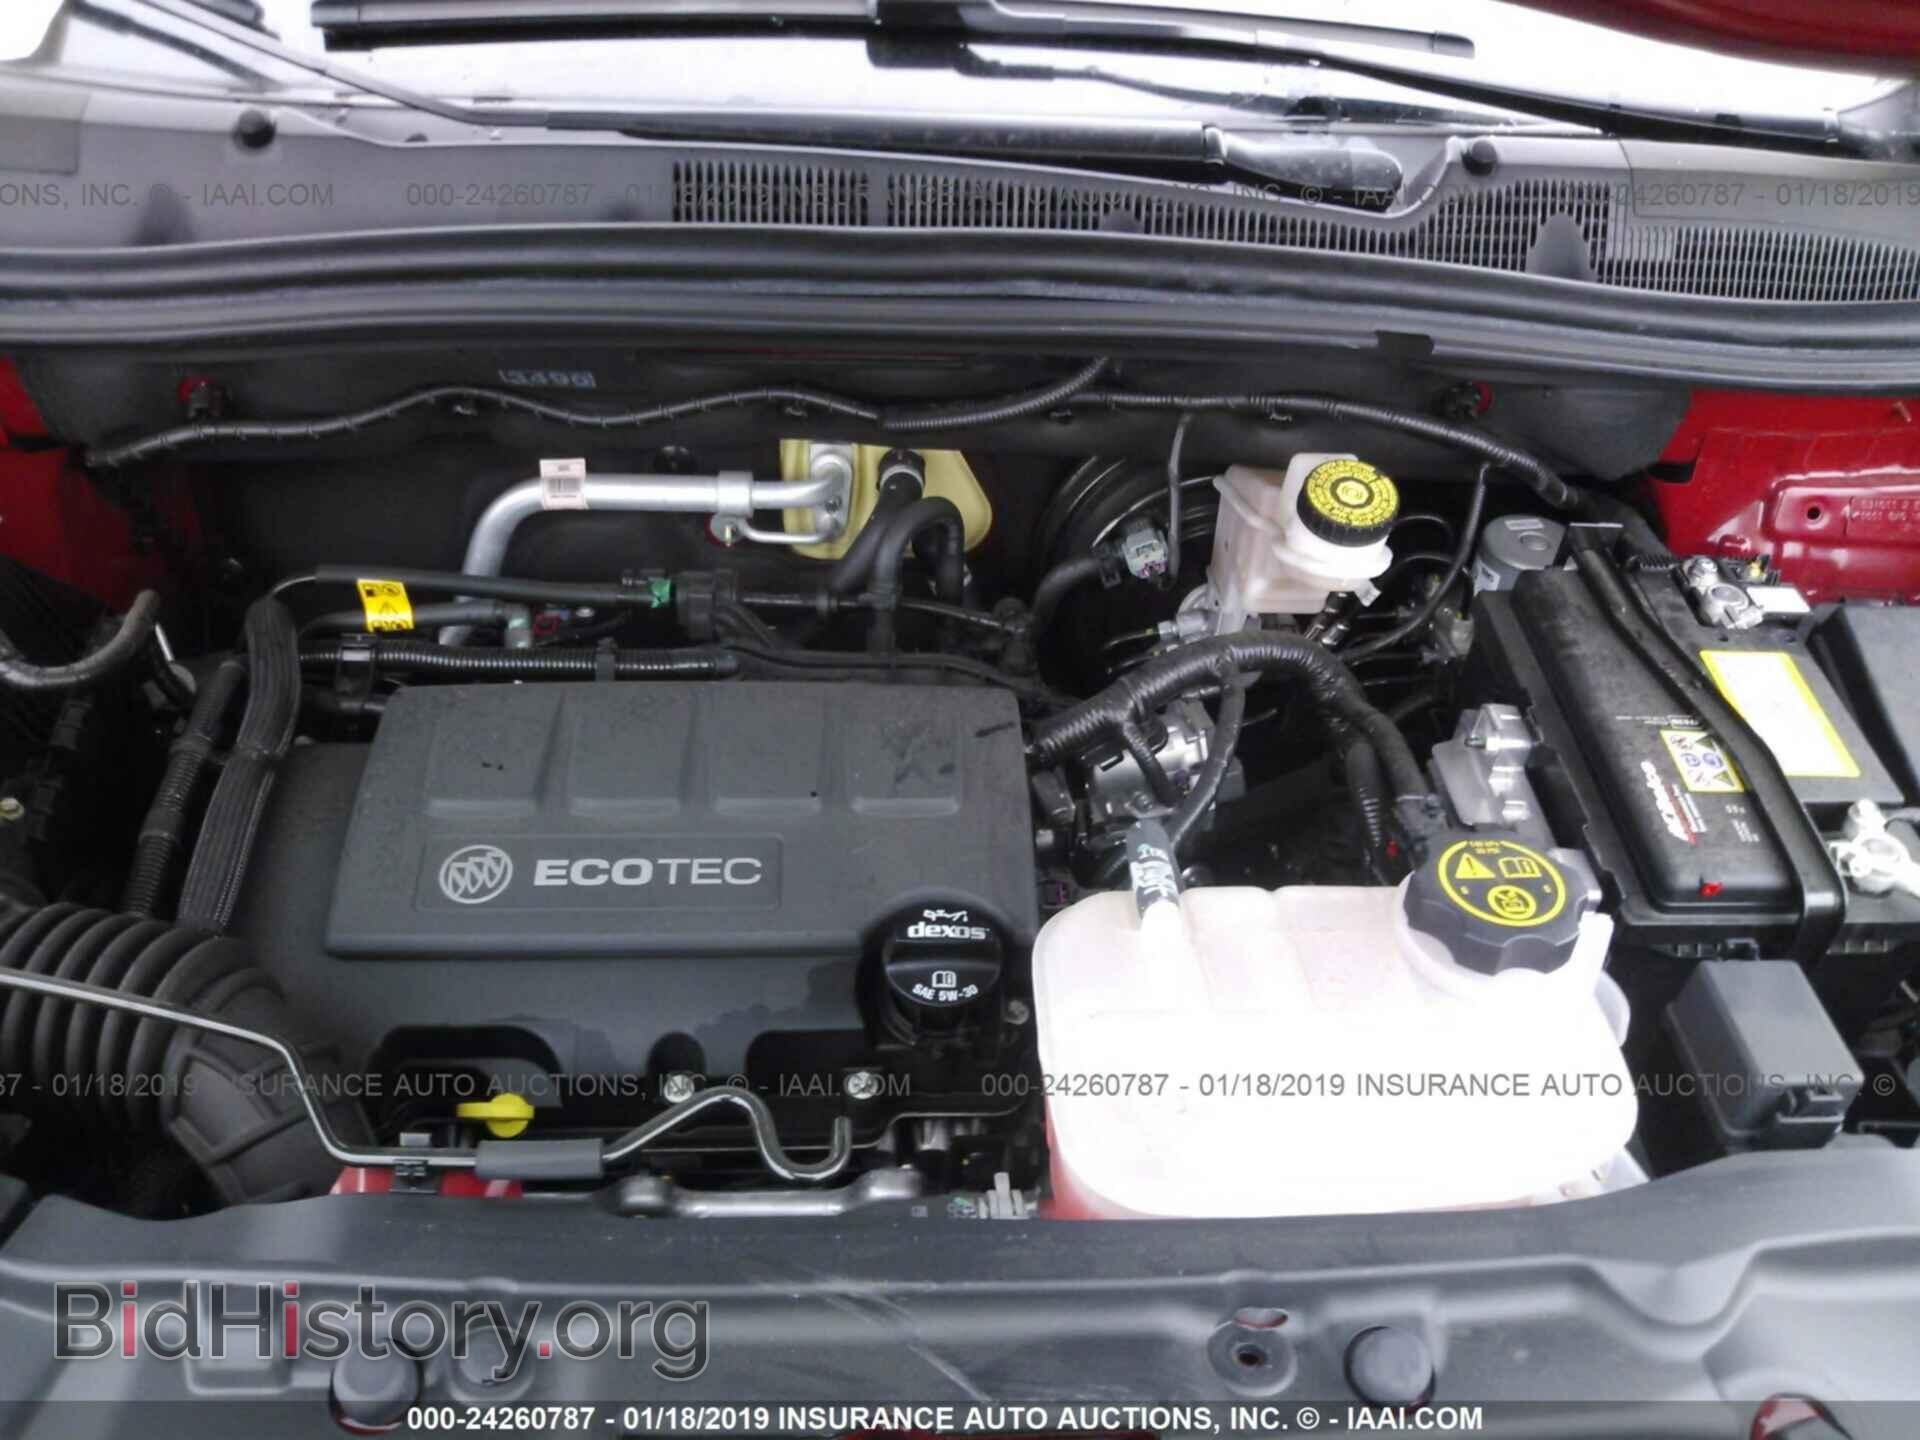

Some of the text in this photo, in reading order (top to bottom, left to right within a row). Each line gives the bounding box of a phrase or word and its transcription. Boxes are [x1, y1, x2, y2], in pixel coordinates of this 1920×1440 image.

[533, 857, 762, 886] ECOTEC
[907, 921, 986, 939] dexos
[912, 983, 979, 1001] SAE 5W-30
